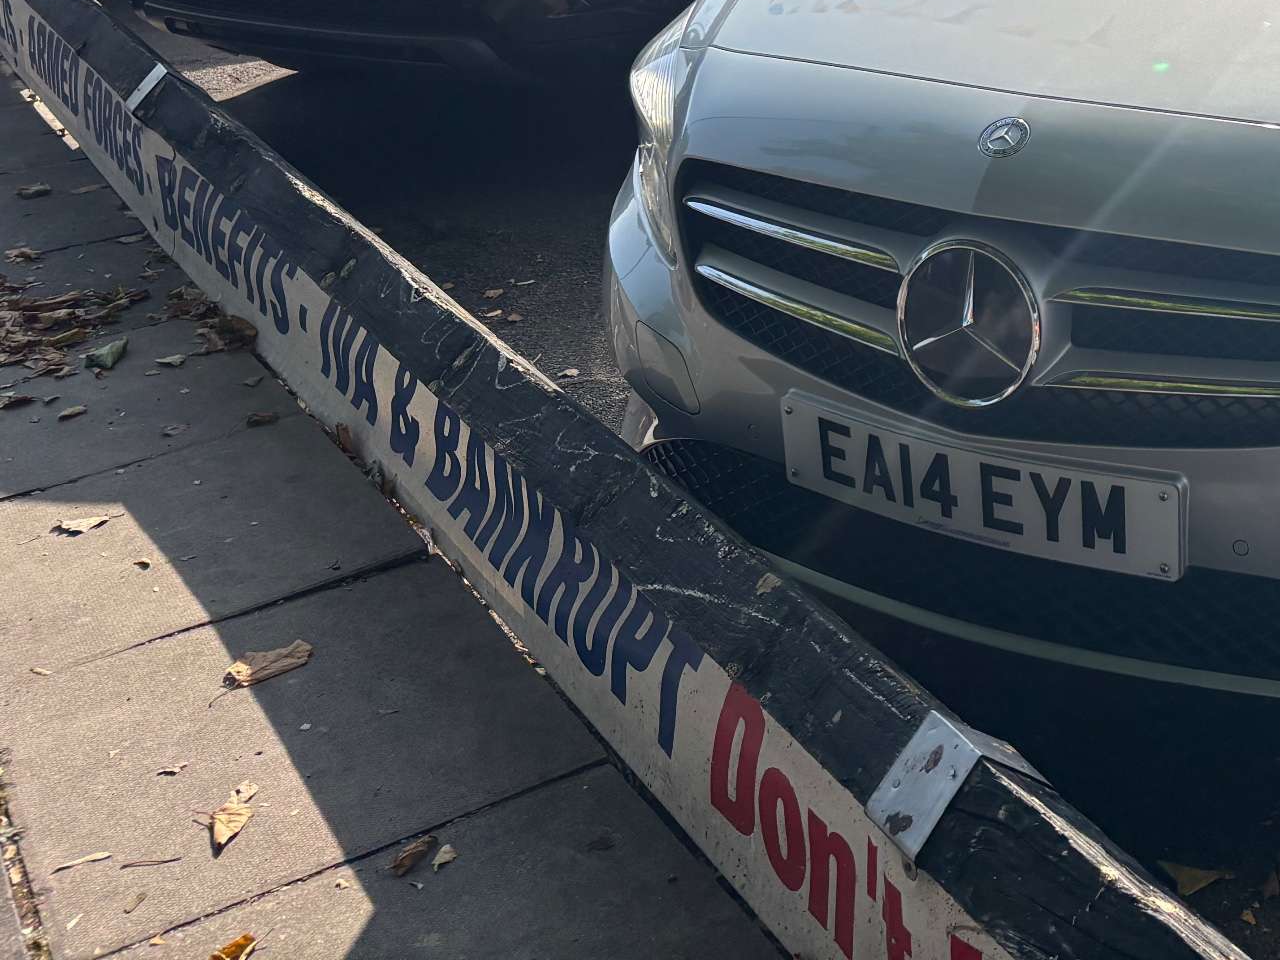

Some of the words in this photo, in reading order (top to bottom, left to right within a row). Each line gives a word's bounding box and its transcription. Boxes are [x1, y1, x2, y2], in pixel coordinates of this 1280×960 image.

[27, 14, 80, 118] ARMED
[83, 68, 146, 196] FORCES
[156, 154, 300, 336] BENEFITS
[320, 296, 381, 426] IVA
[390, 368, 419, 468] &
[425, 395, 707, 760] BANKRUPT
[818, 416, 958, 520] EA14
[980, 461, 1127, 555] EYM
[709, 679, 913, 960] Don't
